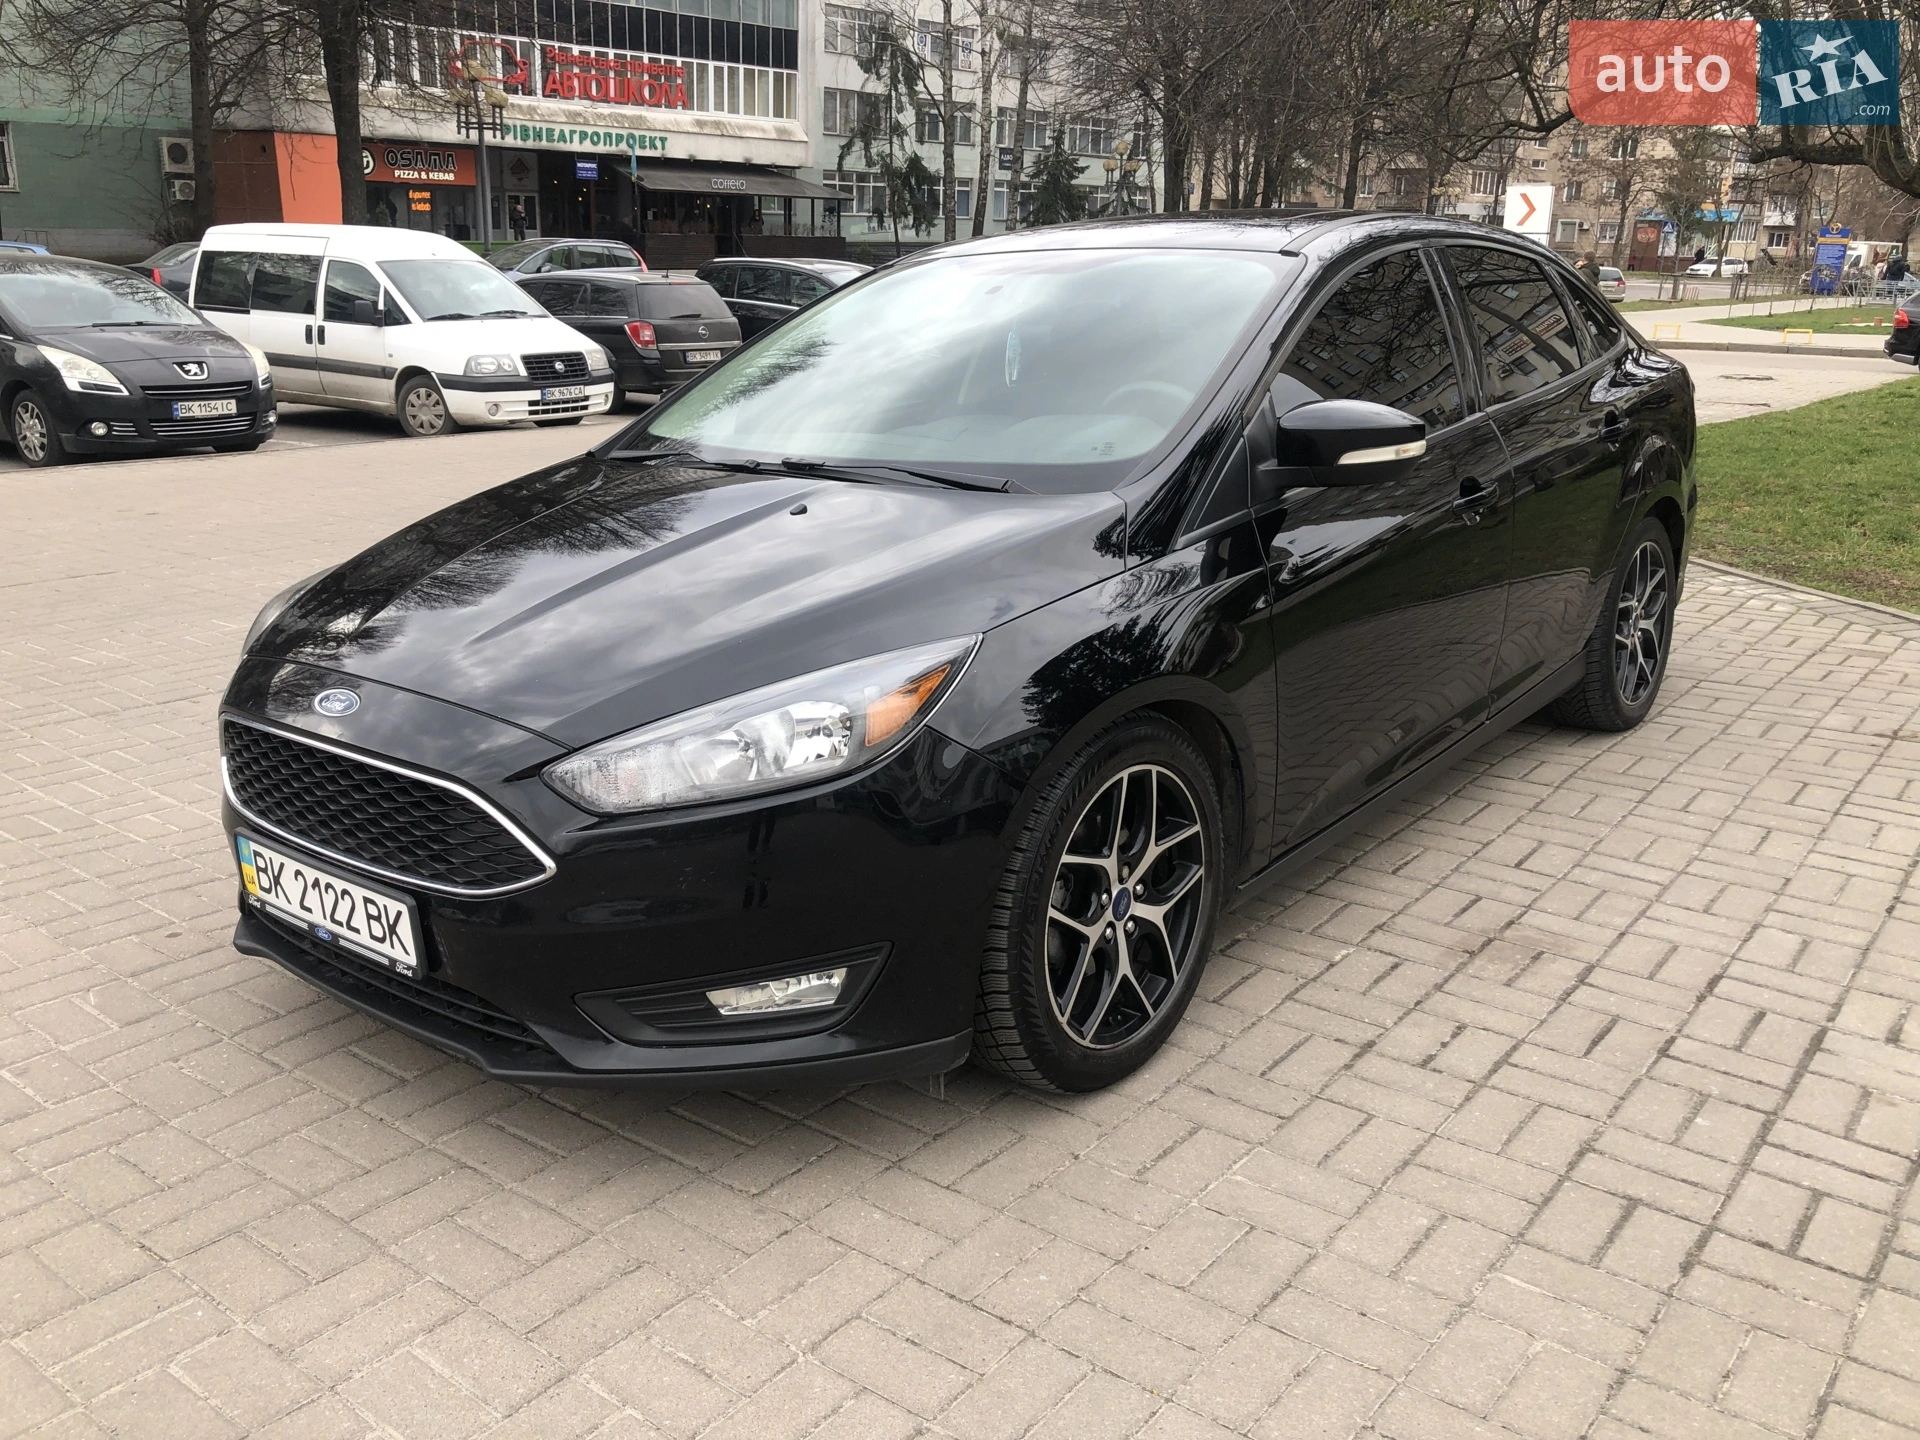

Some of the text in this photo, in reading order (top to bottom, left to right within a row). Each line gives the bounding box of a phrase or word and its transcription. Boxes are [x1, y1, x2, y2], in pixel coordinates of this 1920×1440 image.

[545, 46, 686, 78] Рівненська приватна
[544, 69, 689, 109] АВТОШКОЛА
[502, 124, 668, 150] РІВНЕАГРОПРОЕКТ
[394, 169, 455, 181] PIZZA & KEBAB
[179, 404, 195, 415] BK
[197, 402, 219, 413] 1154
[321, 693, 350, 711] Ford
[245, 872, 258, 888] UA
[248, 894, 261, 909] Ford
[252, 848, 411, 957] BK 2122 BK
[395, 961, 413, 977] Ford
